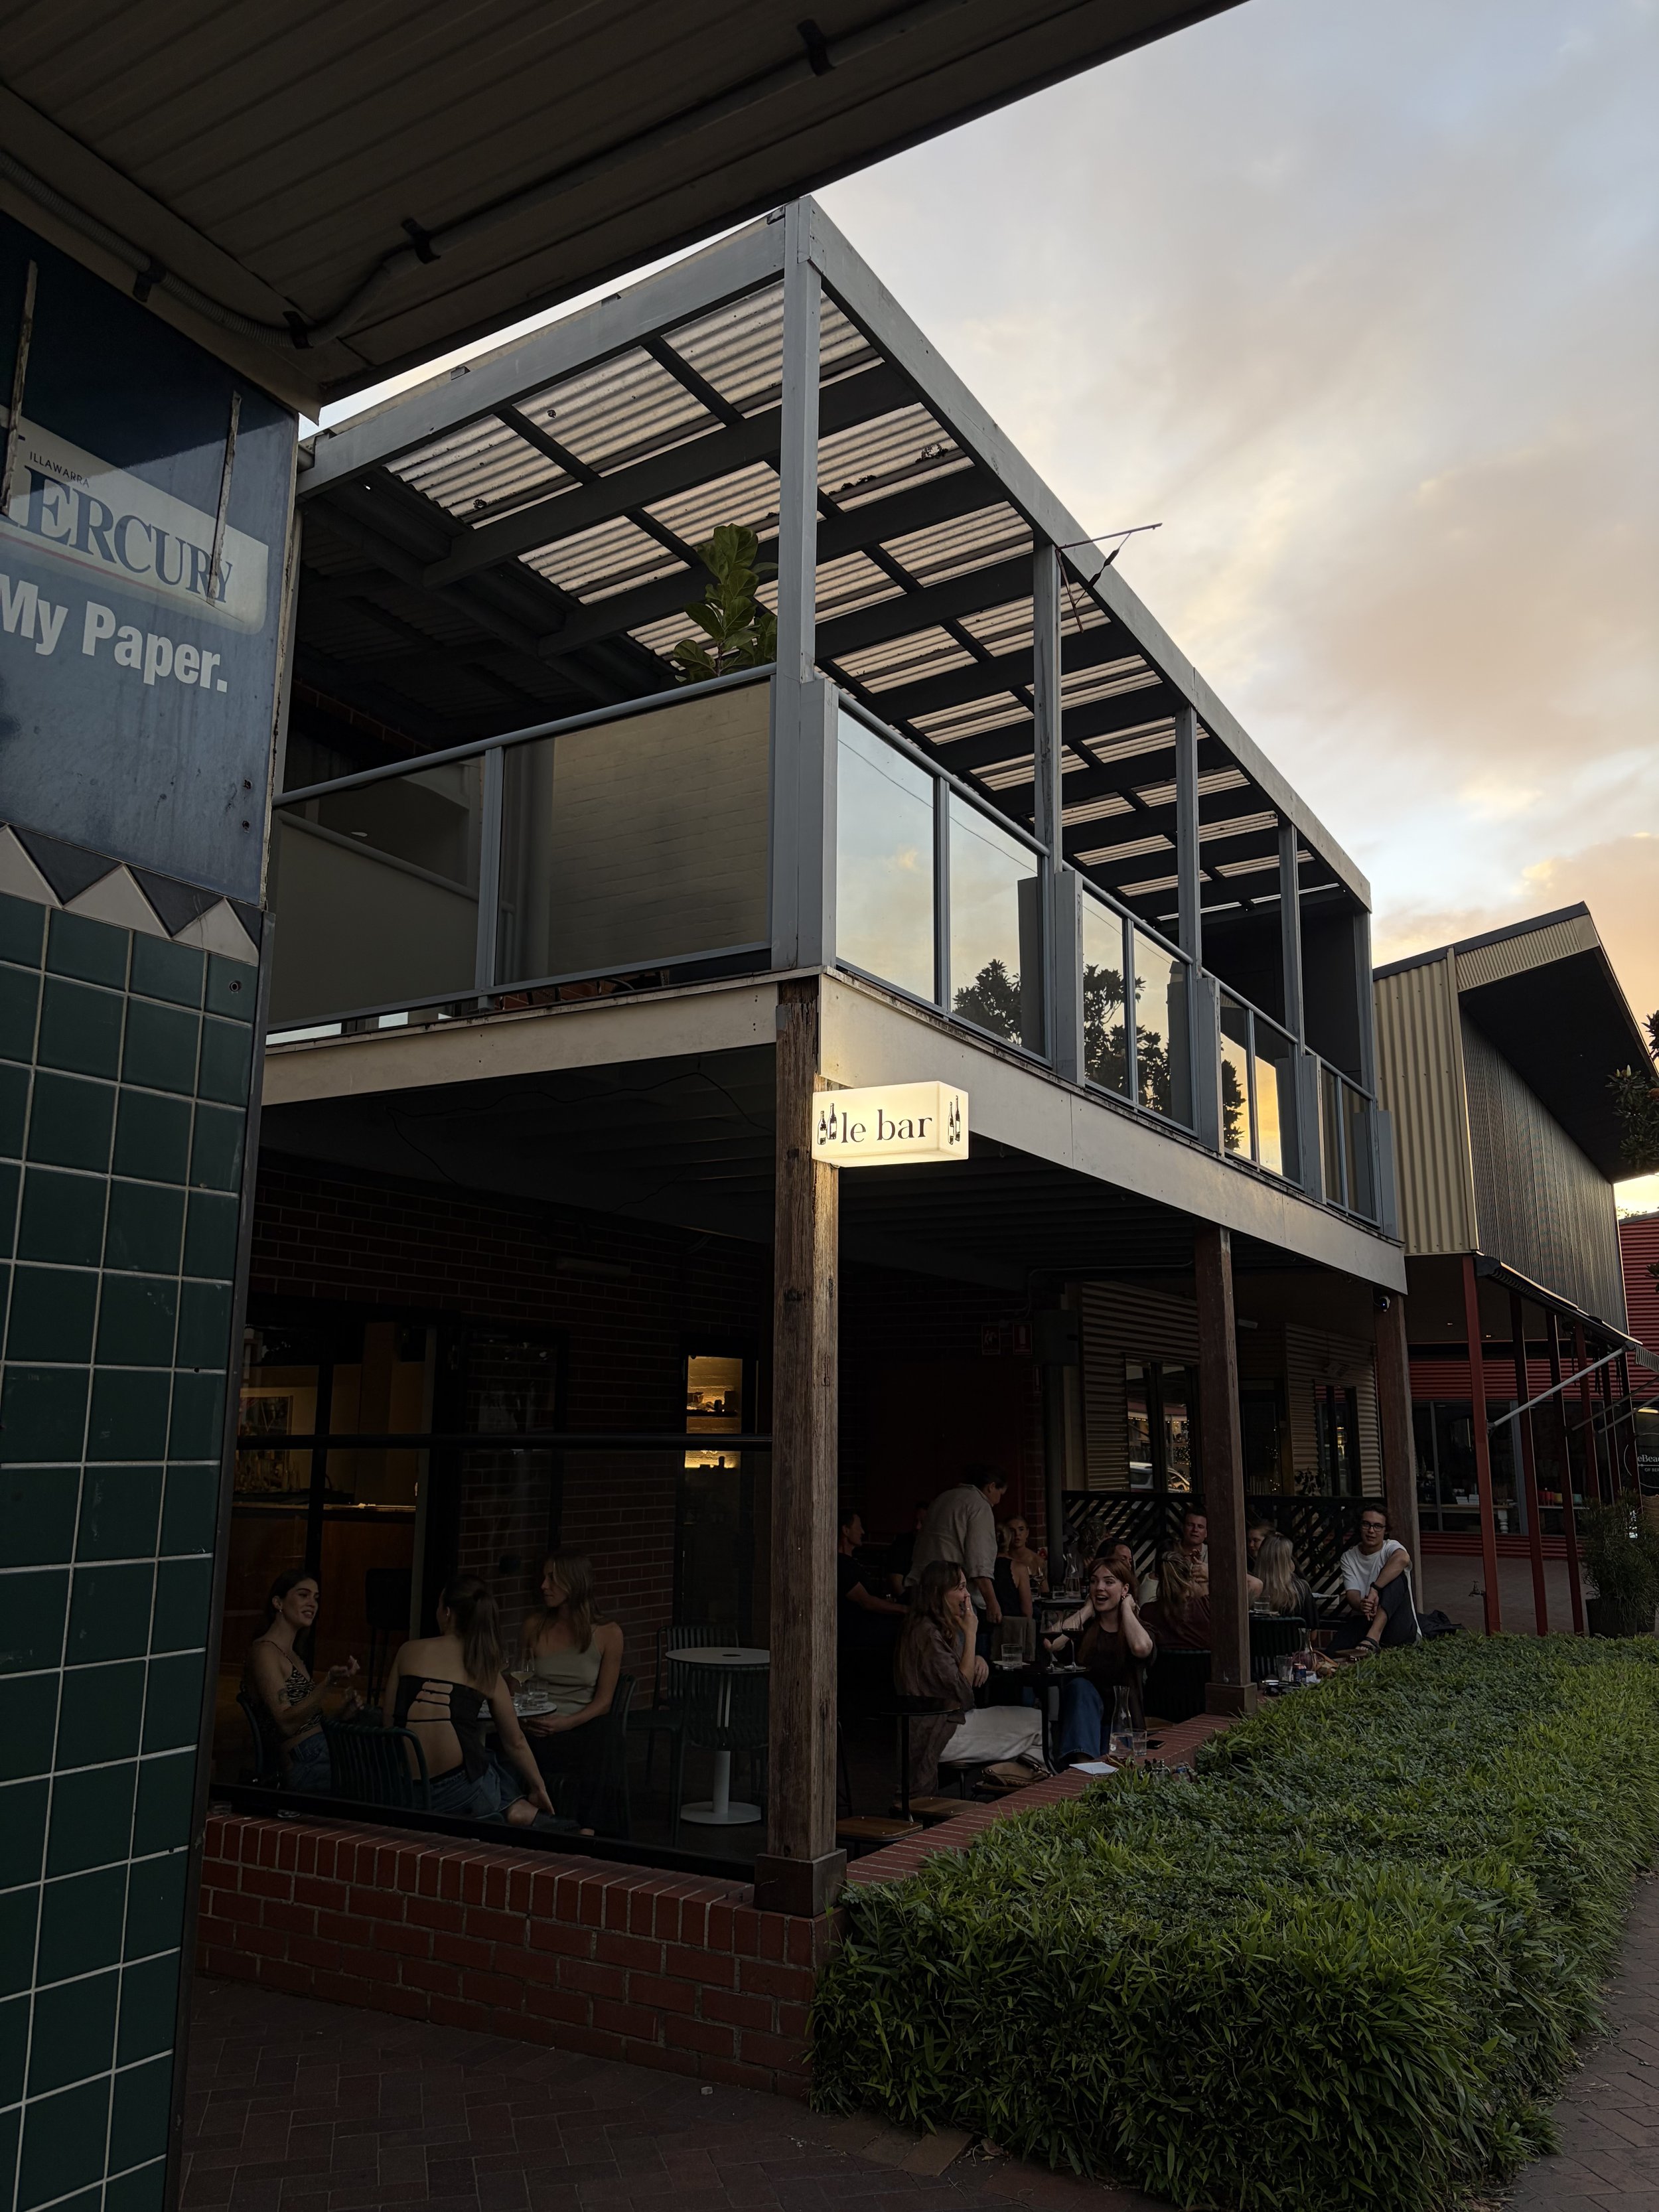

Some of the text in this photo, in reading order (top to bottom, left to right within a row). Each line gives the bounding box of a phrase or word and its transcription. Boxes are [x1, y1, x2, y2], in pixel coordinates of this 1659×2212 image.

[30, 451, 90, 488] ILLAWARRA
[0, 435, 232, 603] ERCURY
[0, 573, 228, 693] My Paper.
[841, 1109, 932, 1143] le bar
[1637, 1454, 1659, 1463] eBea
